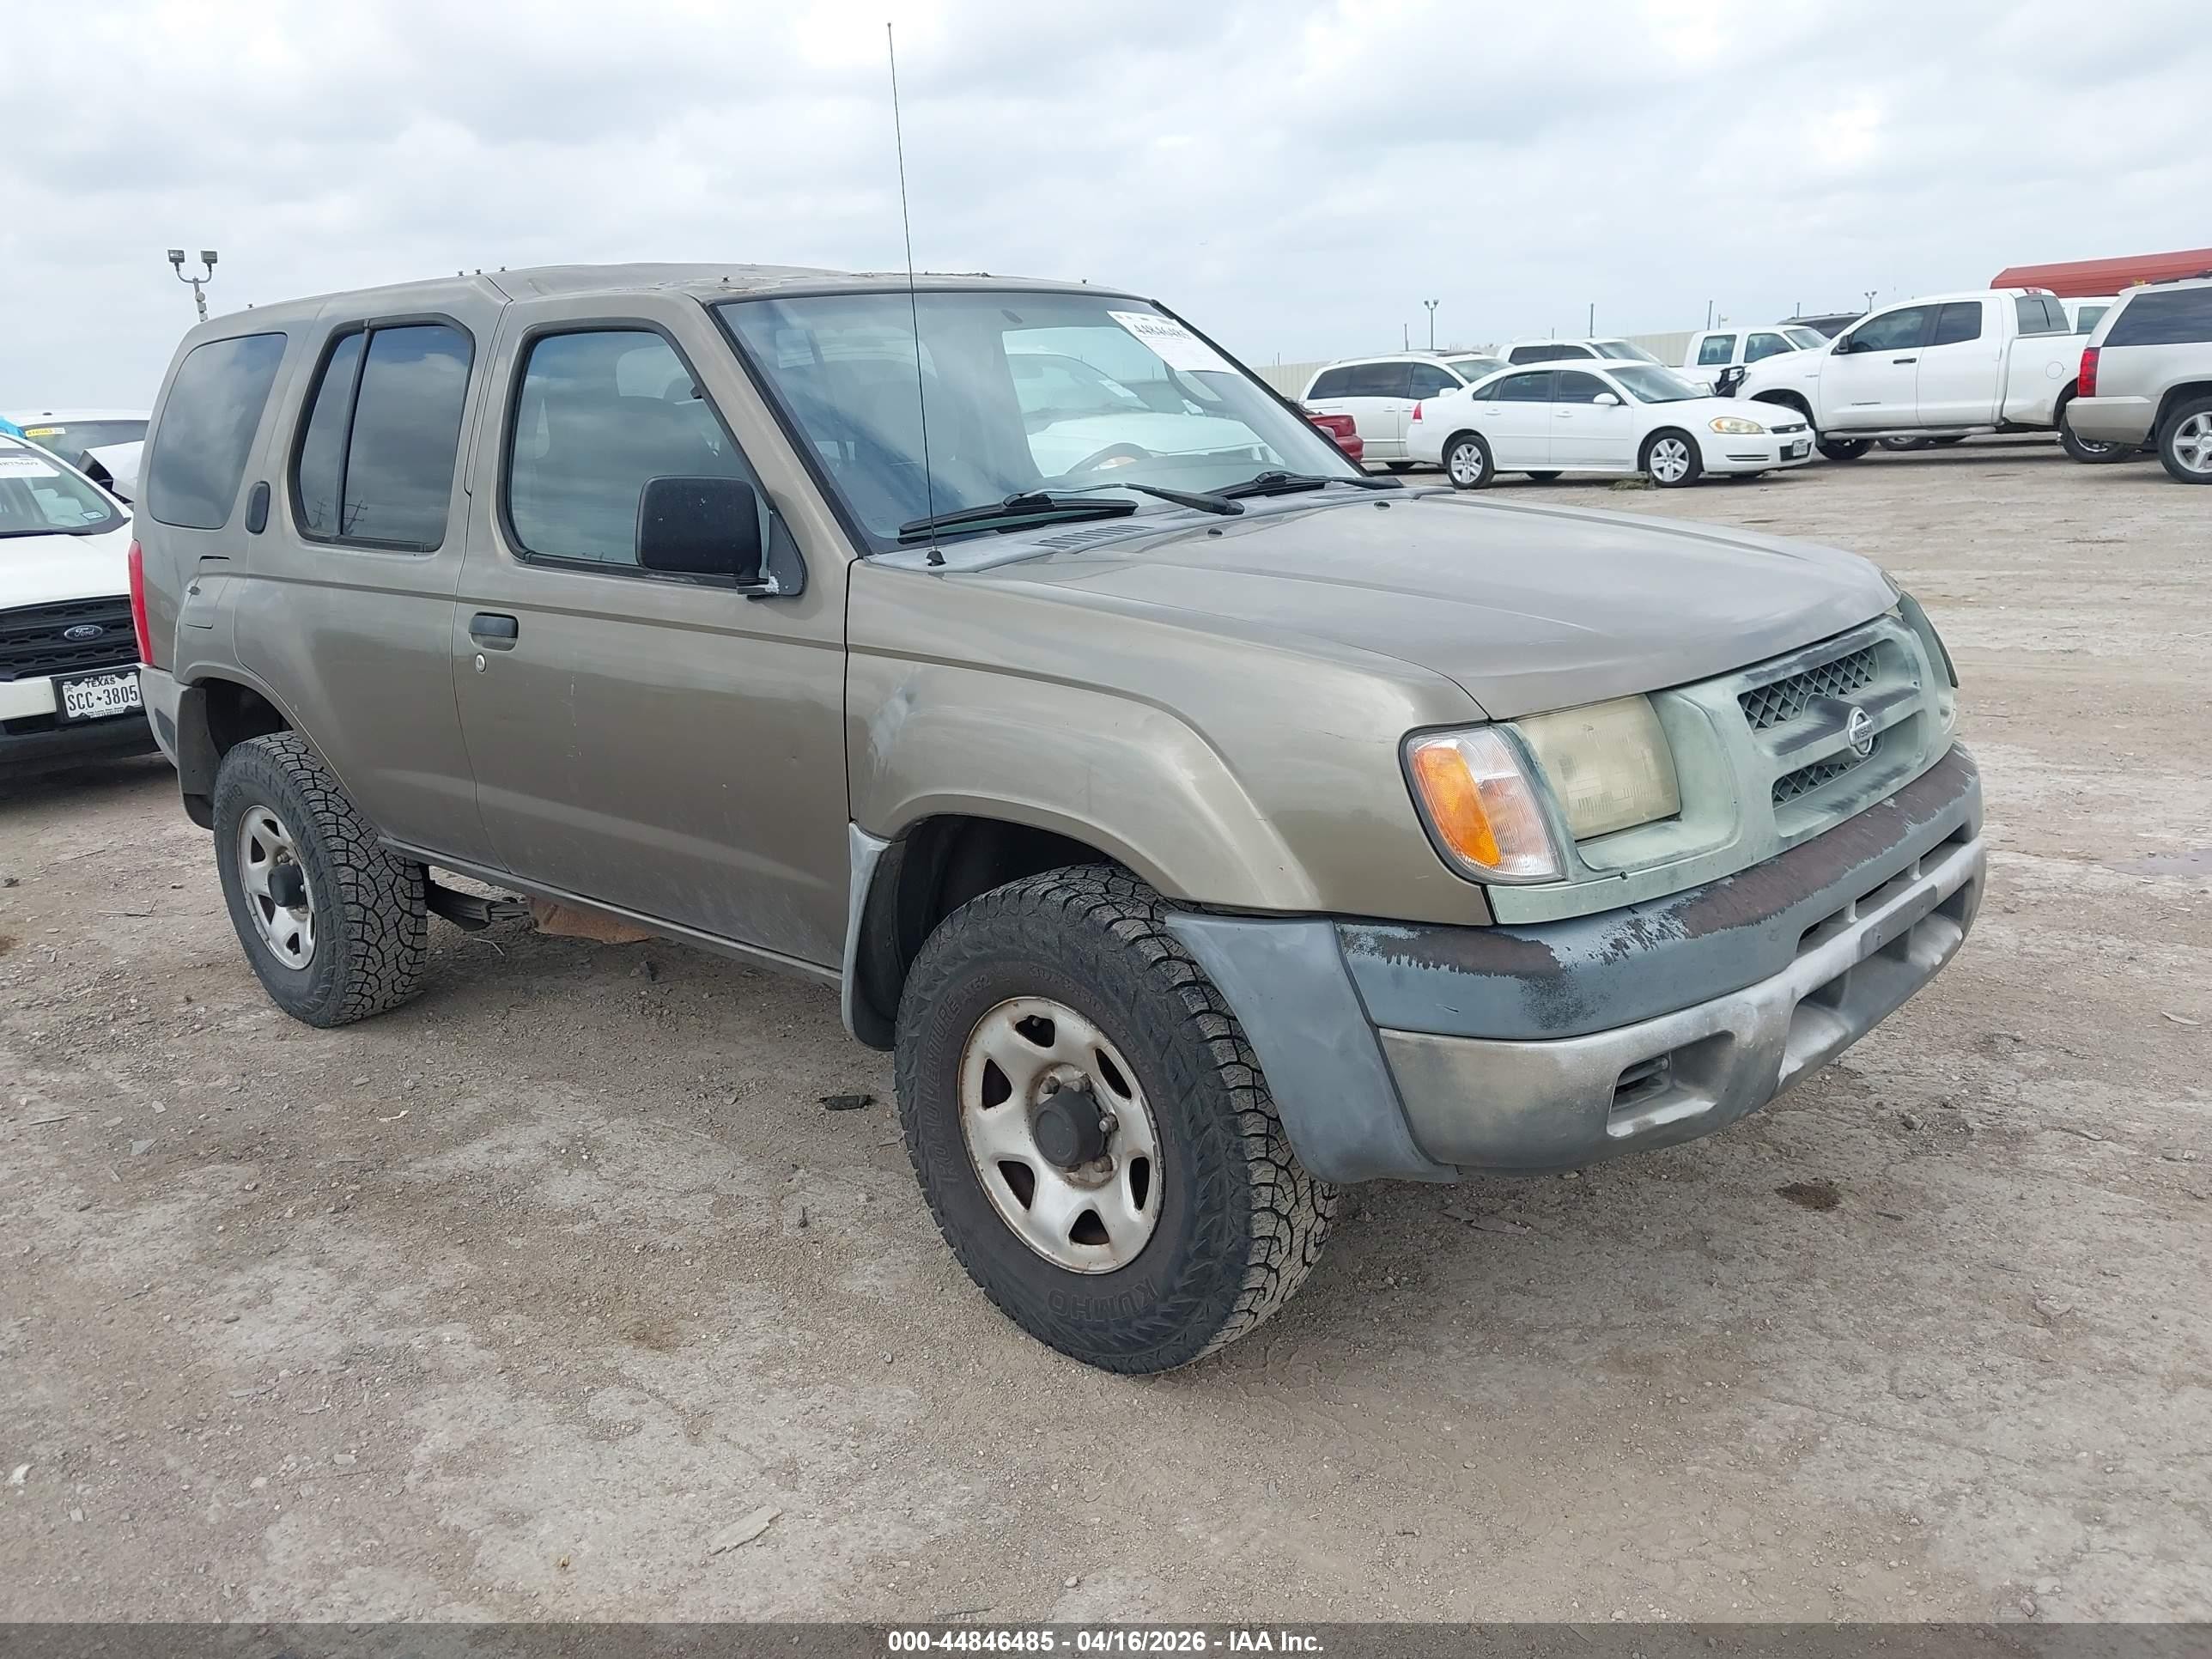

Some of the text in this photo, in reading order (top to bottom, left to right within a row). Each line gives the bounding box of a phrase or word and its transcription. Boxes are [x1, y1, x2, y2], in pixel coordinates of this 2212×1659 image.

[74, 627, 94, 637] Ford
[85, 677, 116, 688] TEXAS
[67, 684, 138, 711] SCC 3805
[1047, 1277, 1159, 1322] KUMHO
